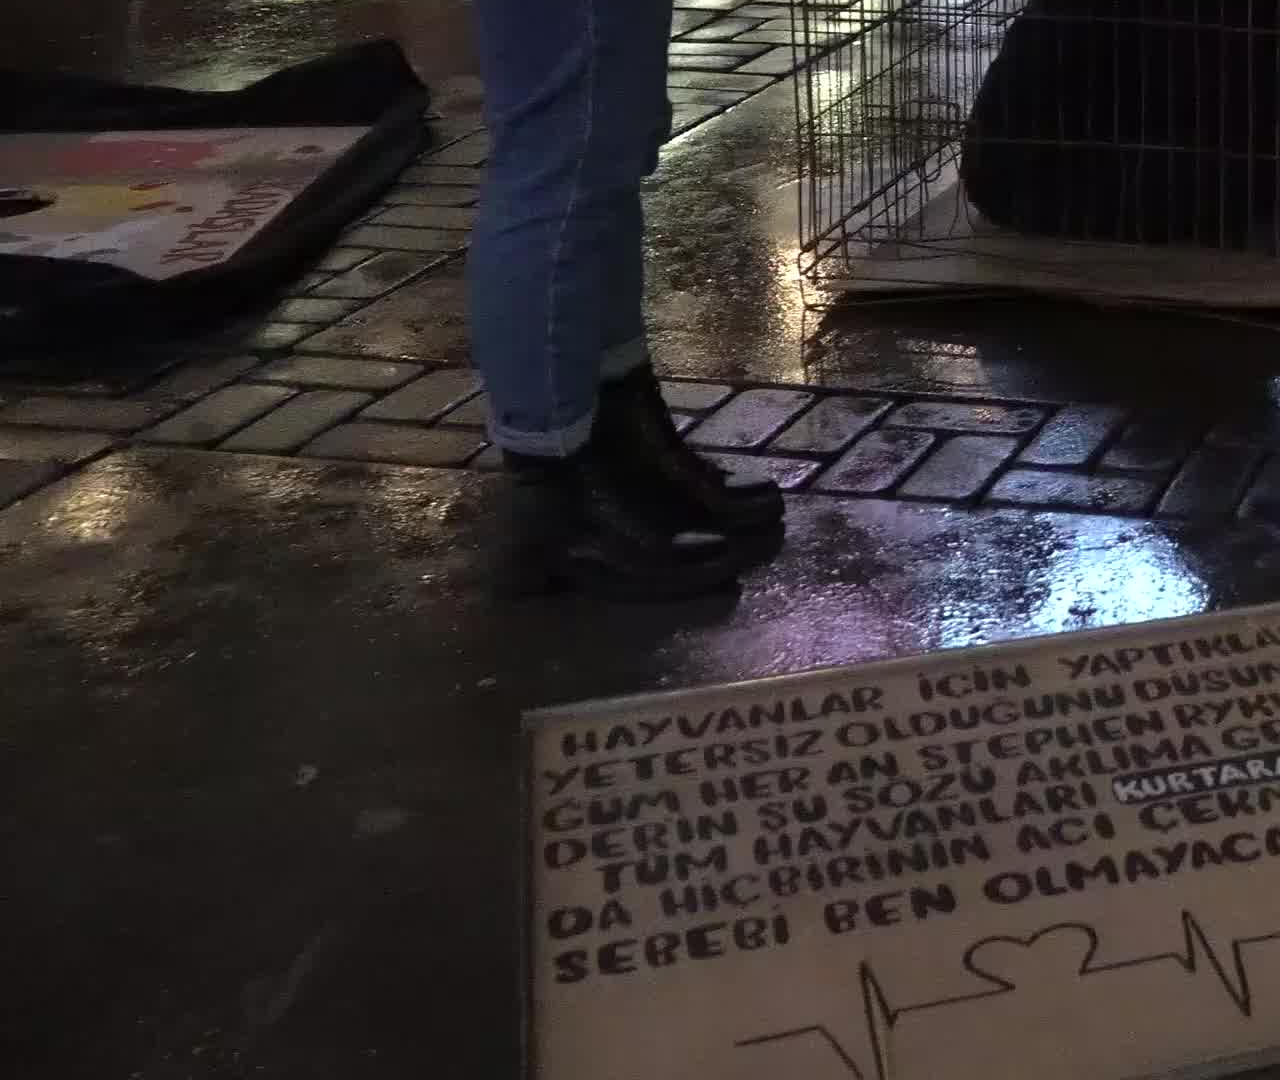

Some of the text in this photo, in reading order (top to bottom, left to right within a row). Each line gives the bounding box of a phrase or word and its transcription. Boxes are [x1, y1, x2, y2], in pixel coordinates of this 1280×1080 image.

[560, 686, 884, 757] HAYVANLAR
[699, 766, 811, 808] HER
[826, 751, 899, 788] AN
[918, 708, 1167, 771] STEPHEN
[1016, 733, 1210, 789] AKLIMA
[752, 780, 1098, 867] HAYVANLARI
[547, 899, 633, 940] DA
[1017, 812, 1116, 854] ACI
[553, 905, 790, 985] SEBEBİ
[823, 882, 958, 935] BEN
